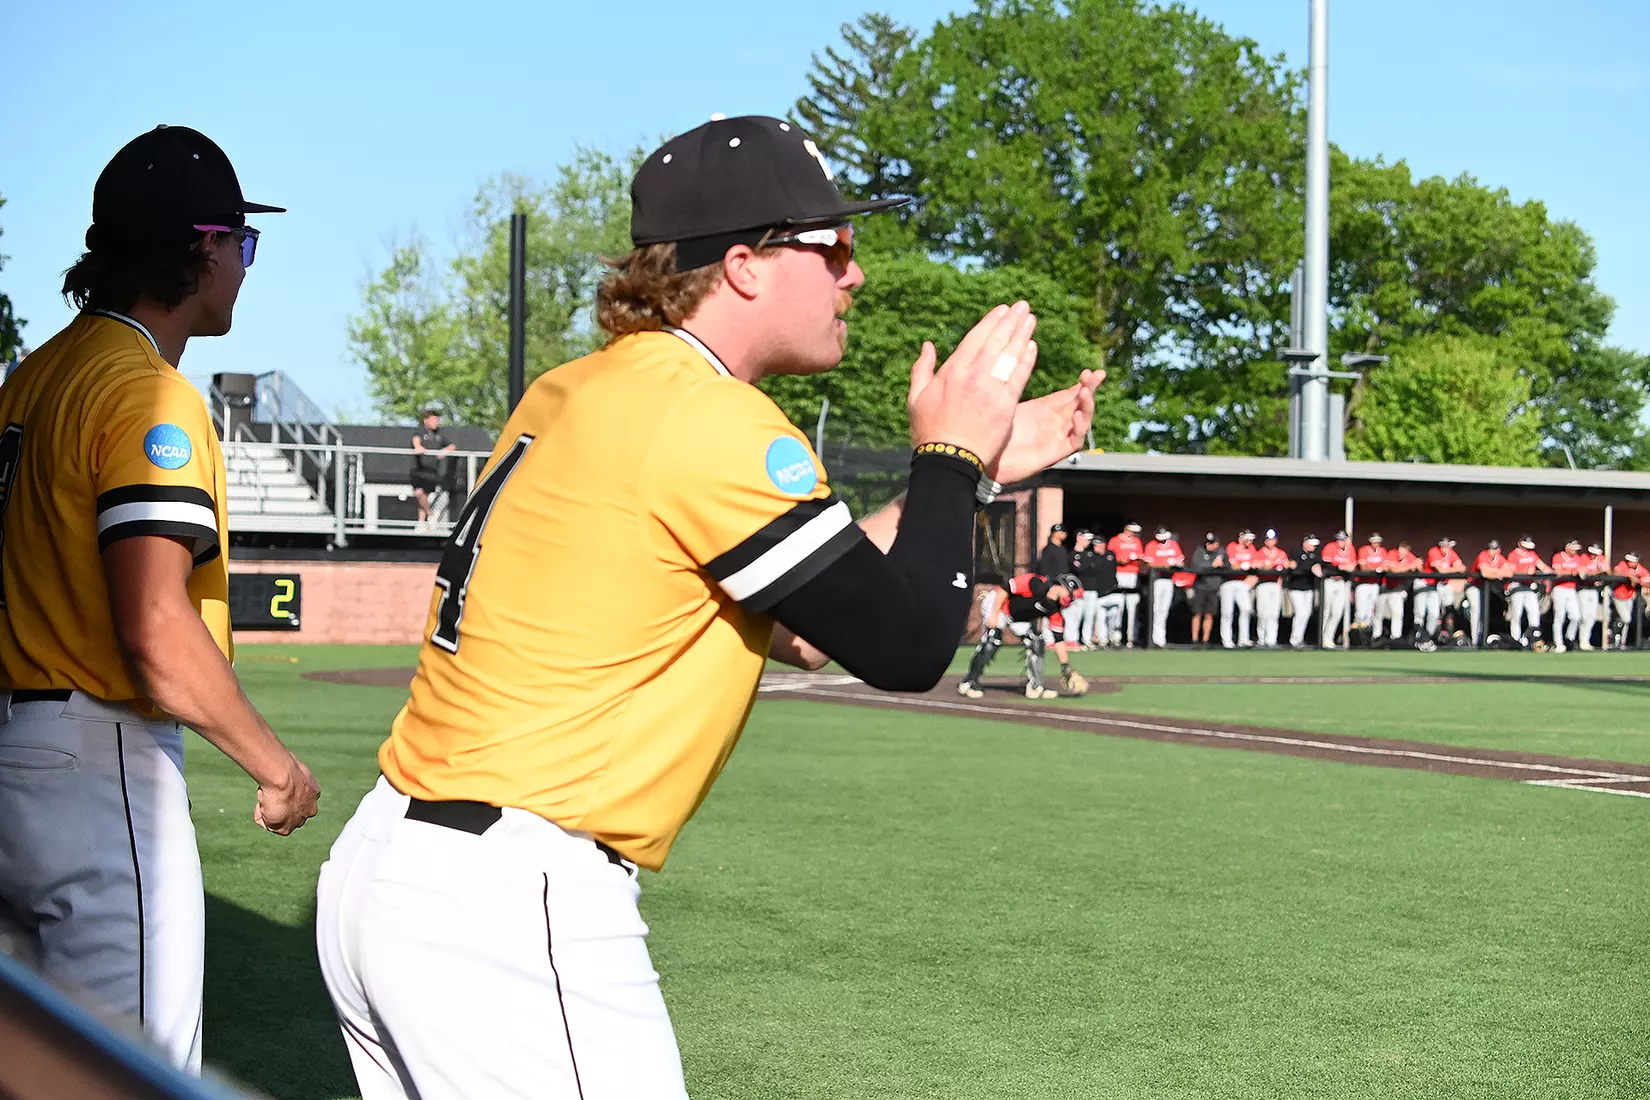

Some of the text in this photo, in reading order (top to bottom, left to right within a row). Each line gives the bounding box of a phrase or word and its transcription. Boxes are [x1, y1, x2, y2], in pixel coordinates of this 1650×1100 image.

[150, 443, 189, 459] NCAA
[431, 433, 536, 655] 4
[270, 579, 295, 618] 2
